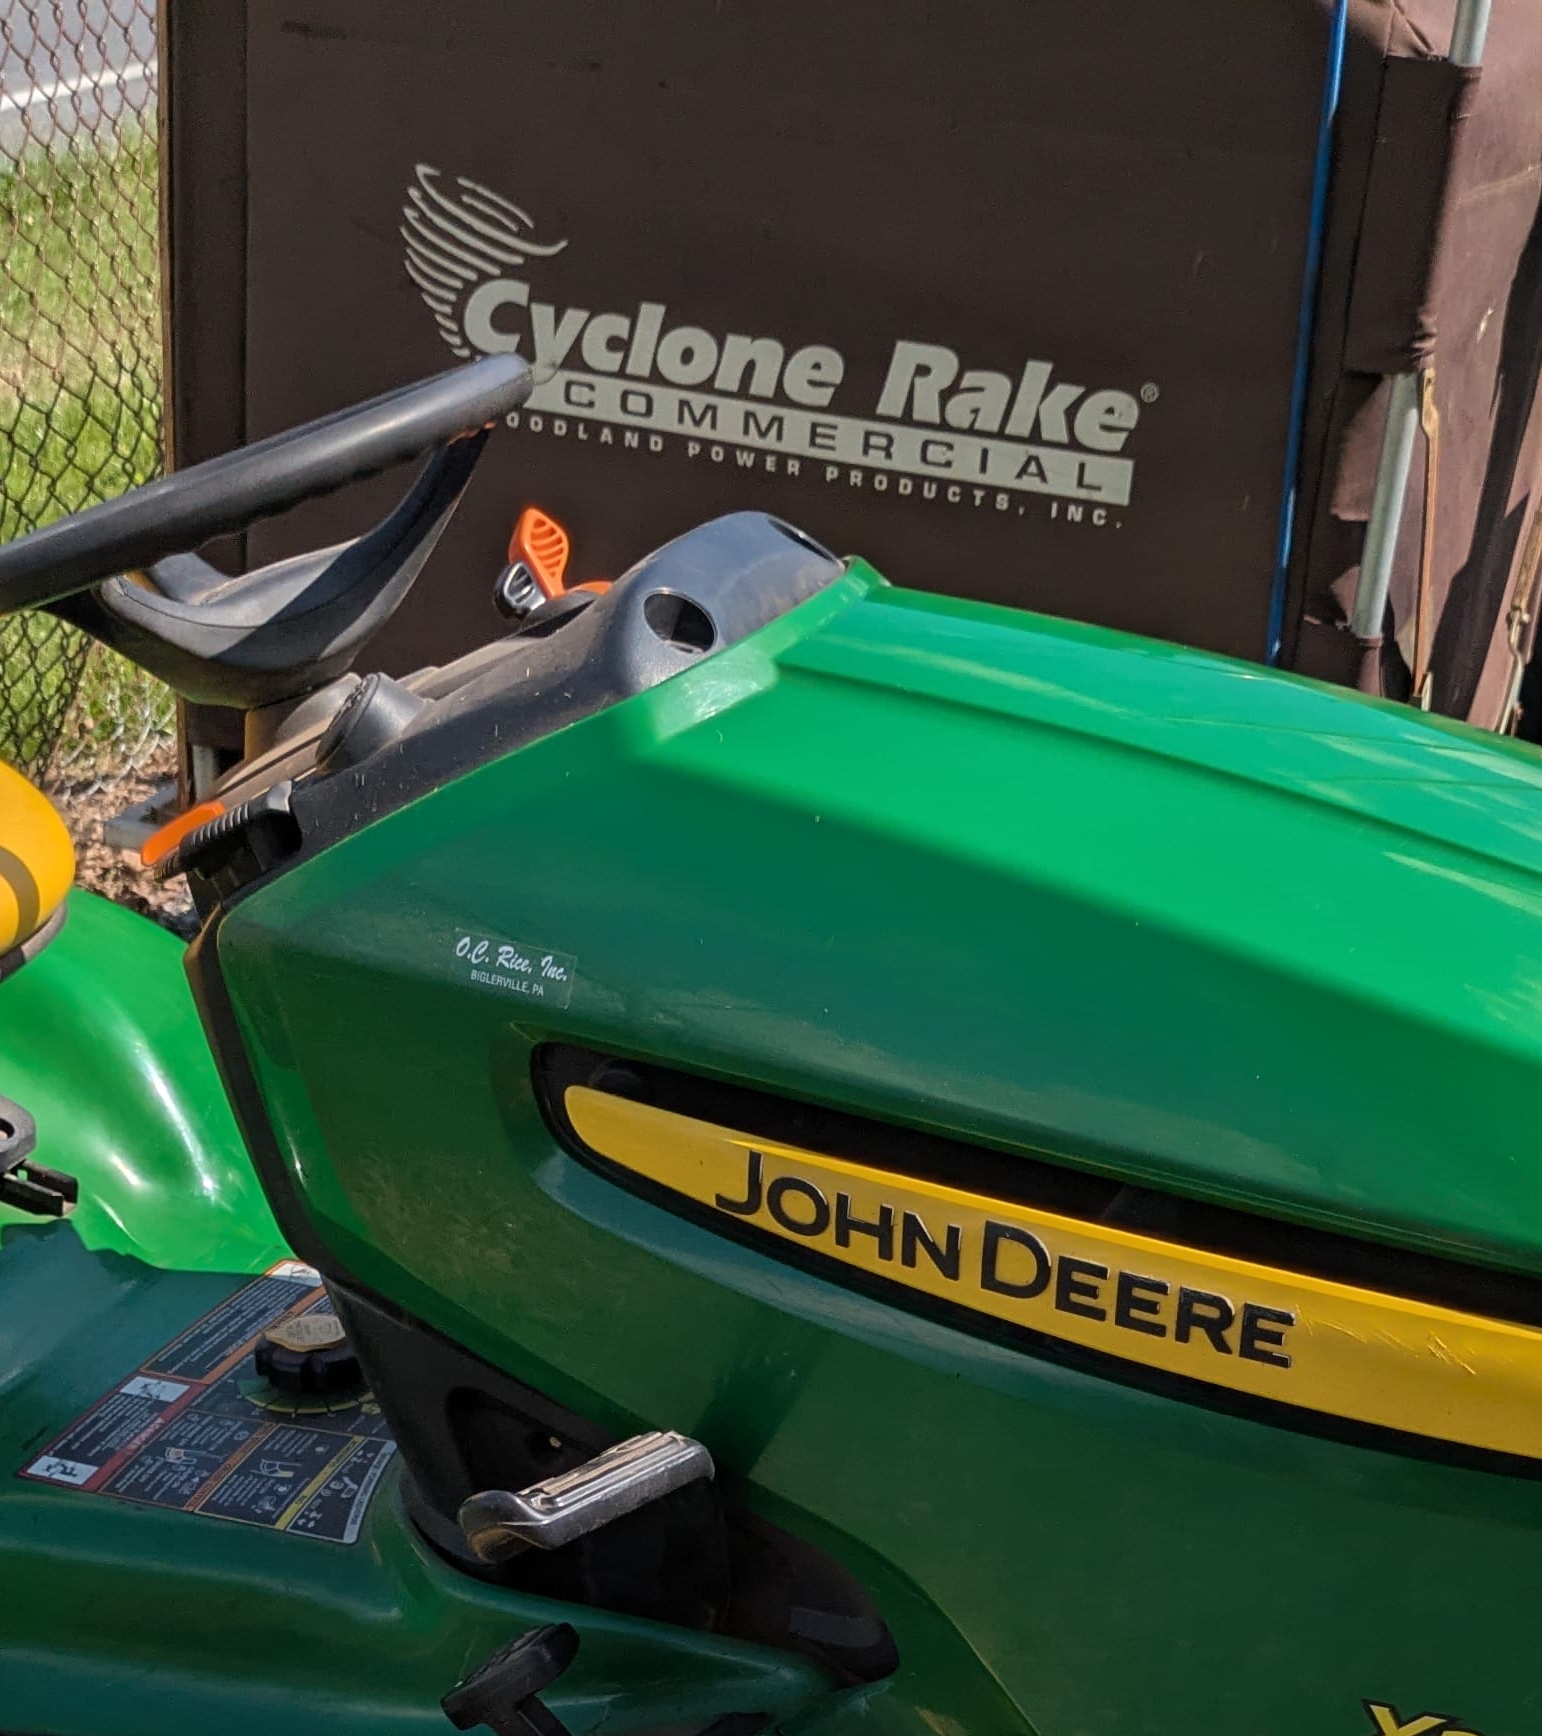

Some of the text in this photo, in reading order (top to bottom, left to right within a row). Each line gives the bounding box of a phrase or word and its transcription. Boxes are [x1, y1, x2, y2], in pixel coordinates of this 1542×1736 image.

[463, 278, 845, 407] Cyclone
[506, 411, 1123, 530] OODLAND POWER PRODUCTS, INC.
[562, 380, 1103, 493] COMMERCIAL
[455, 936, 490, 965] O.C.
[540, 955, 568, 982] Inc.
[532, 982, 545, 997] PA
[713, 1148, 1297, 1370] JOHN DEERE
